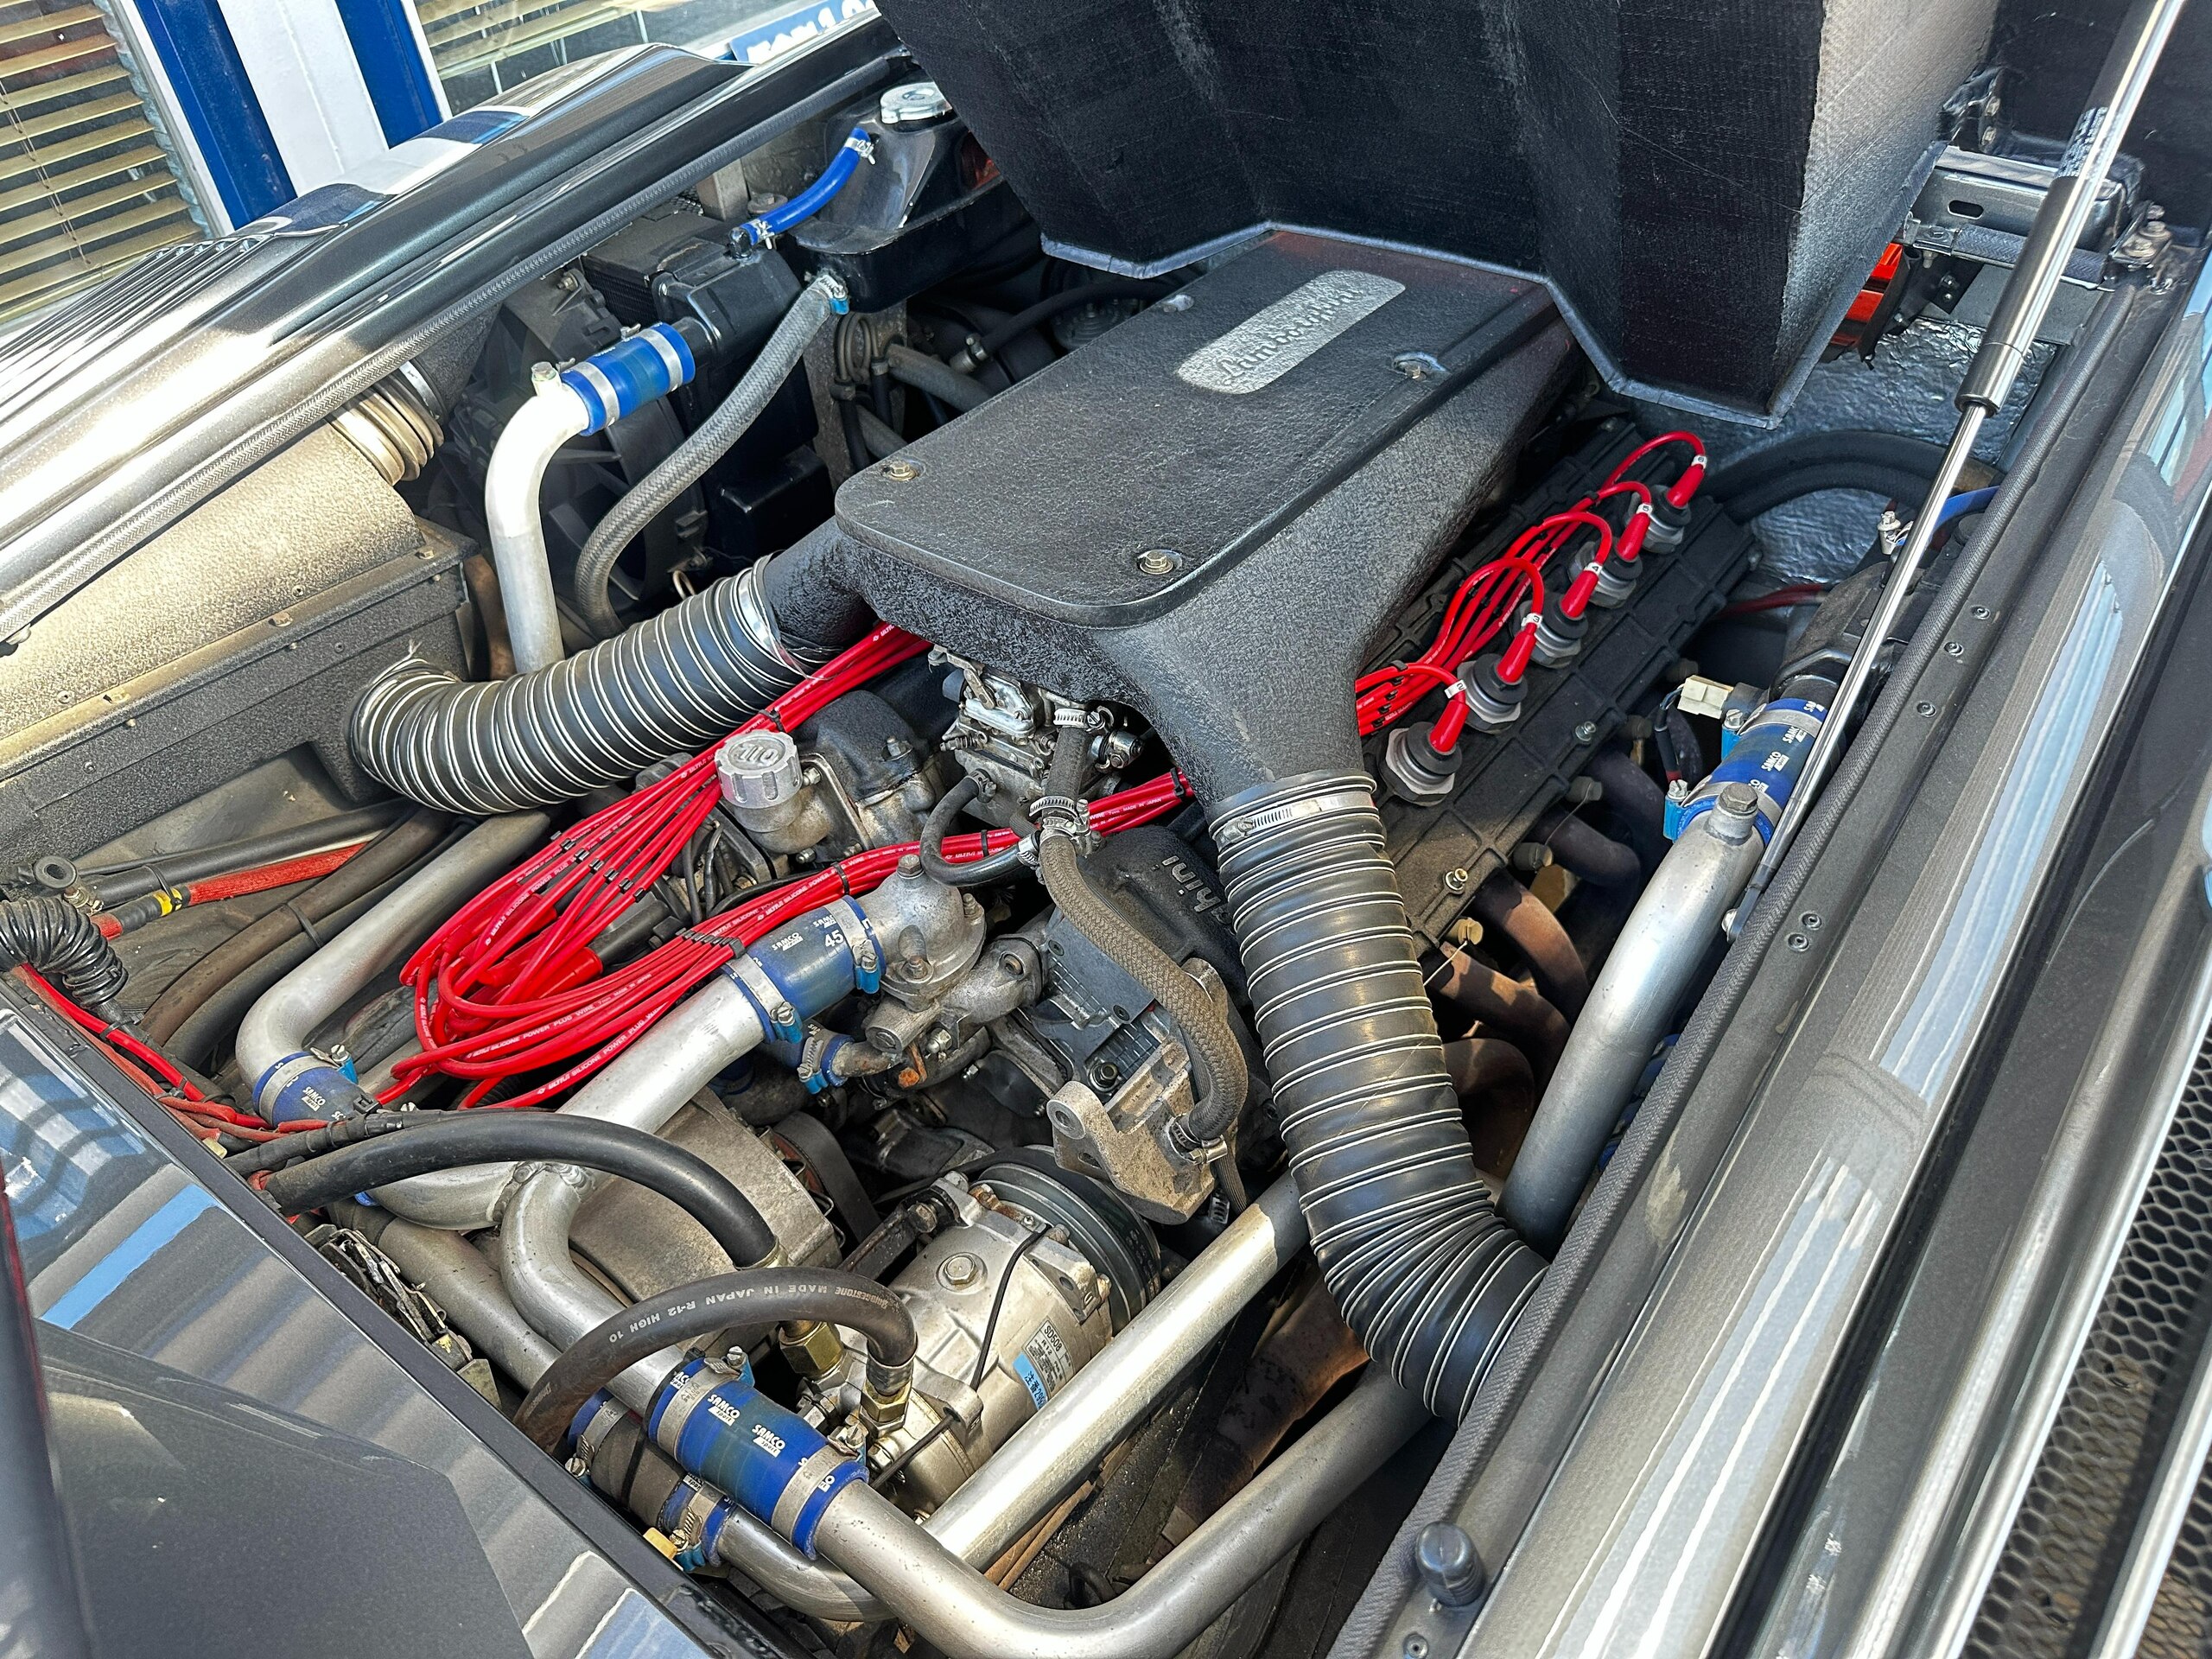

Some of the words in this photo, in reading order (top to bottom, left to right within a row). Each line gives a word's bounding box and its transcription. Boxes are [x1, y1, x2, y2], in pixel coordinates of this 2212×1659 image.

[739, 743, 779, 766] OIL
[1760, 751, 1782, 772] SAMCO
[784, 885, 808, 904] SILICONE
[808, 873, 830, 888] POWER
[771, 932, 801, 951] SAMCO
[823, 930, 844, 948] 45
[490, 1036, 520, 1051] SILICONE
[523, 1025, 550, 1039] POWER
[553, 1015, 573, 1027] PLUG
[575, 1004, 596, 1016] WIRE
[571, 1054, 602, 1077] SILICONE
[602, 1034, 627, 1055] POWER
[627, 1019, 645, 1035] PLUG
[302, 1087, 326, 1106] SAMCO
[705, 1287, 755, 1306] JAPAN
[764, 1285, 779, 1294] IN
[788, 1284, 828, 1294] MADE
[667, 1300, 696, 1317] R-12
[629, 1313, 661, 1333] HIGH
[608, 1330, 624, 1344] 10
[1044, 1325, 1063, 1352] SD508
[707, 1394, 741, 1419] SAMCO
[715, 1408, 733, 1423] sport
[751, 1424, 785, 1450] SAMCO
[760, 1440, 778, 1454] sport
